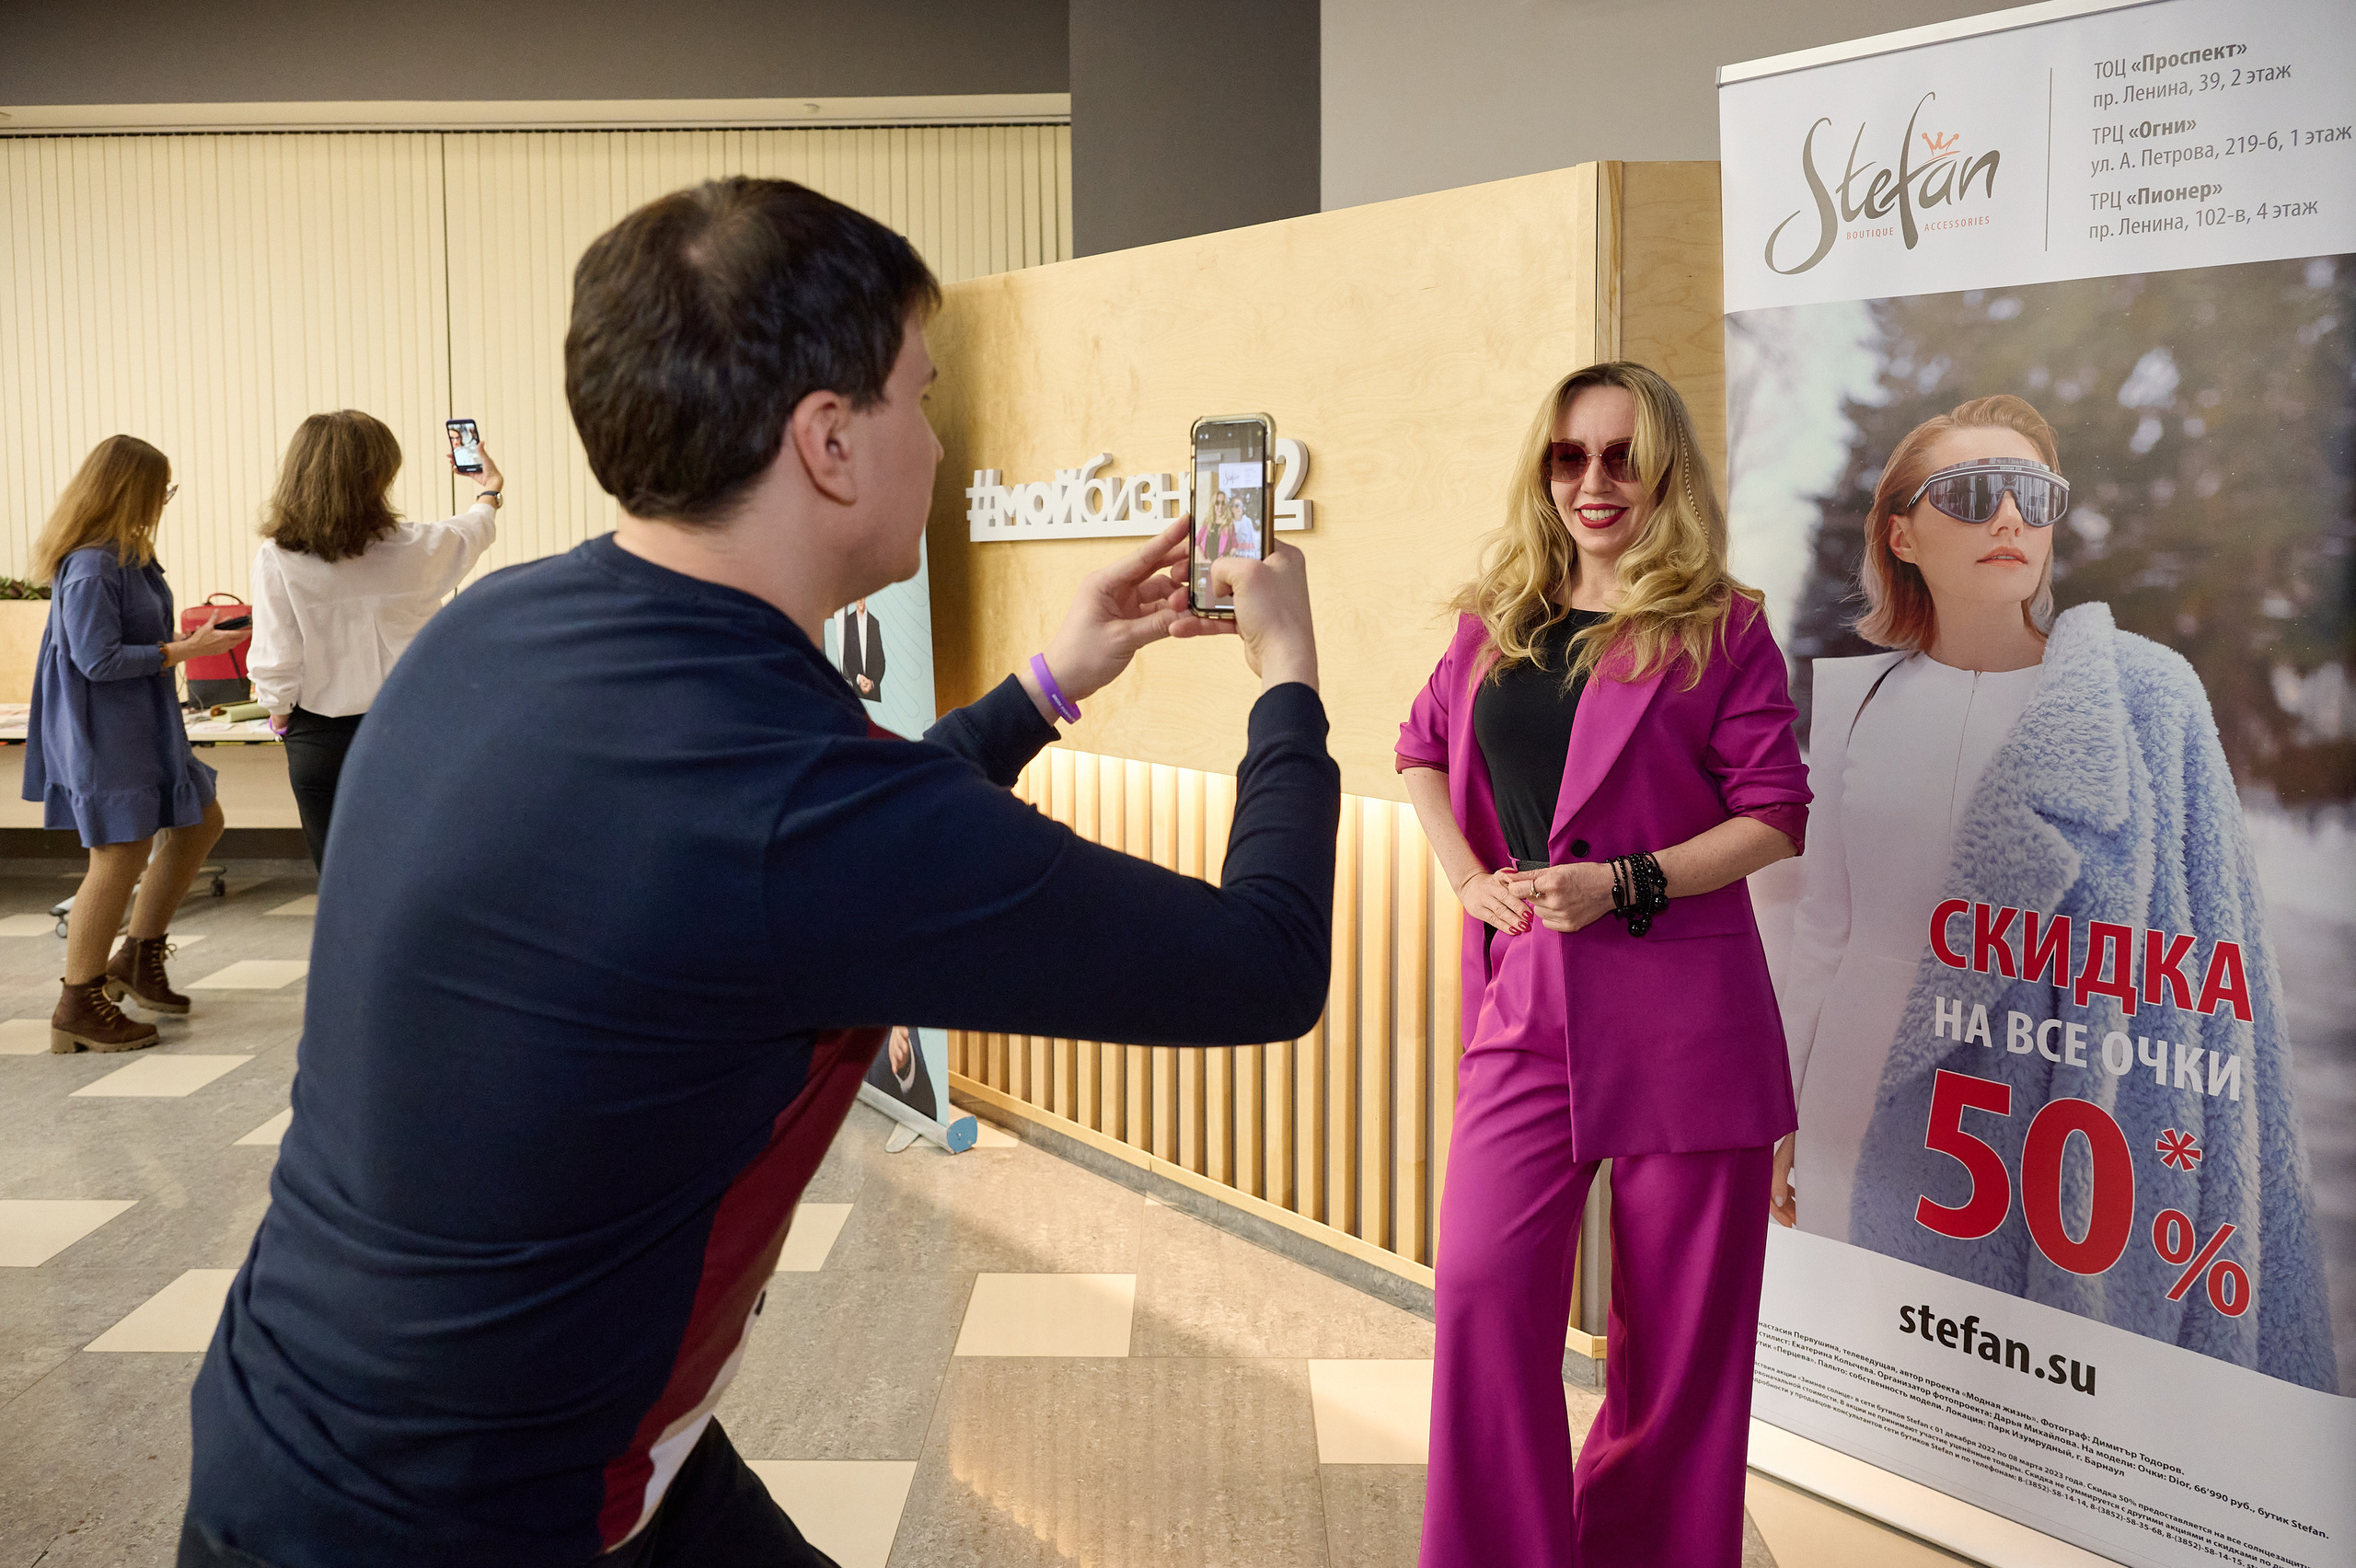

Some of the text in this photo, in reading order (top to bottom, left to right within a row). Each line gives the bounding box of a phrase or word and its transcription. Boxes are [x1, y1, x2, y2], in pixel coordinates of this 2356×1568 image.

[2093, 64, 2292, 110] пр. Ленина, 39, 2 этаж
[2094, 43, 2247, 79] ТОЦ «Проспект»
[2090, 158, 2115, 178] ул.
[2119, 152, 2136, 169] А.
[2142, 144, 2220, 167] Петрова,
[2291, 129, 2299, 146] 1
[2305, 125, 2352, 145] этаж
[2092, 120, 2197, 144] ТРЦ «Огни»
[1764, 91, 2001, 275] Stefan
[2090, 183, 2223, 211] ТРЦ «Пионер»
[1846, 216, 1990, 240] BOUTIQUE ACCESSORIES
[2089, 200, 2318, 242] пр. Ленина, 102-в, 4 этаж
[1929, 897, 2254, 1022] СКИДКА
[1934, 996, 2241, 1101] НА ВСЕ ОЧКИ
[1899, 1304, 2096, 1397] stefan.su
[1773, 1345, 1817, 1364] «Перцева».
[1818, 1359, 1848, 1375] Пальто:
[1848, 1372, 1908, 1397] собственность
[1909, 1394, 1944, 1411] модели.
[1945, 1406, 1986, 1425] Локация:
[1987, 1421, 2010, 1435] Парк
[2012, 1430, 2074, 1458] Изумрудный,
[2085, 1456, 2125, 1476] Барнаул
[1791, 1341, 1832, 1359] Екатерина
[1833, 1355, 1876, 1375] Колычева.
[1877, 1370, 1931, 1396] Организатор
[1932, 1390, 1992, 1417] фотопроекта:
[1992, 1412, 2022, 1428] Дарья
[2023, 1424, 2079, 1448] Михайлова.
[2081, 1443, 2094, 1454] На
[2096, 1450, 2136, 1470] модели:
[2137, 1464, 2166, 1481] Очки:
[2168, 1474, 2192, 1490] Dior,
[2230, 1499, 2255, 1513] руб.,
[2258, 1507, 2289, 1525] бутик
[2291, 1520, 2329, 1539] Stefan.
[1794, 1332, 1842, 1353] Первушина,
[1842, 1349, 1898, 1373] телеведущая,
[1899, 1369, 1923, 1384] автор
[1924, 1378, 1960, 1395] проекта
[1961, 1391, 2001, 1410] «Модная
[2002, 1406, 2038, 1423] жизнь».
[2040, 1419, 2090, 1441] Фотограф:
[2091, 1436, 2137, 1458] Димитър
[2139, 1453, 2185, 1475] Тодоров.
